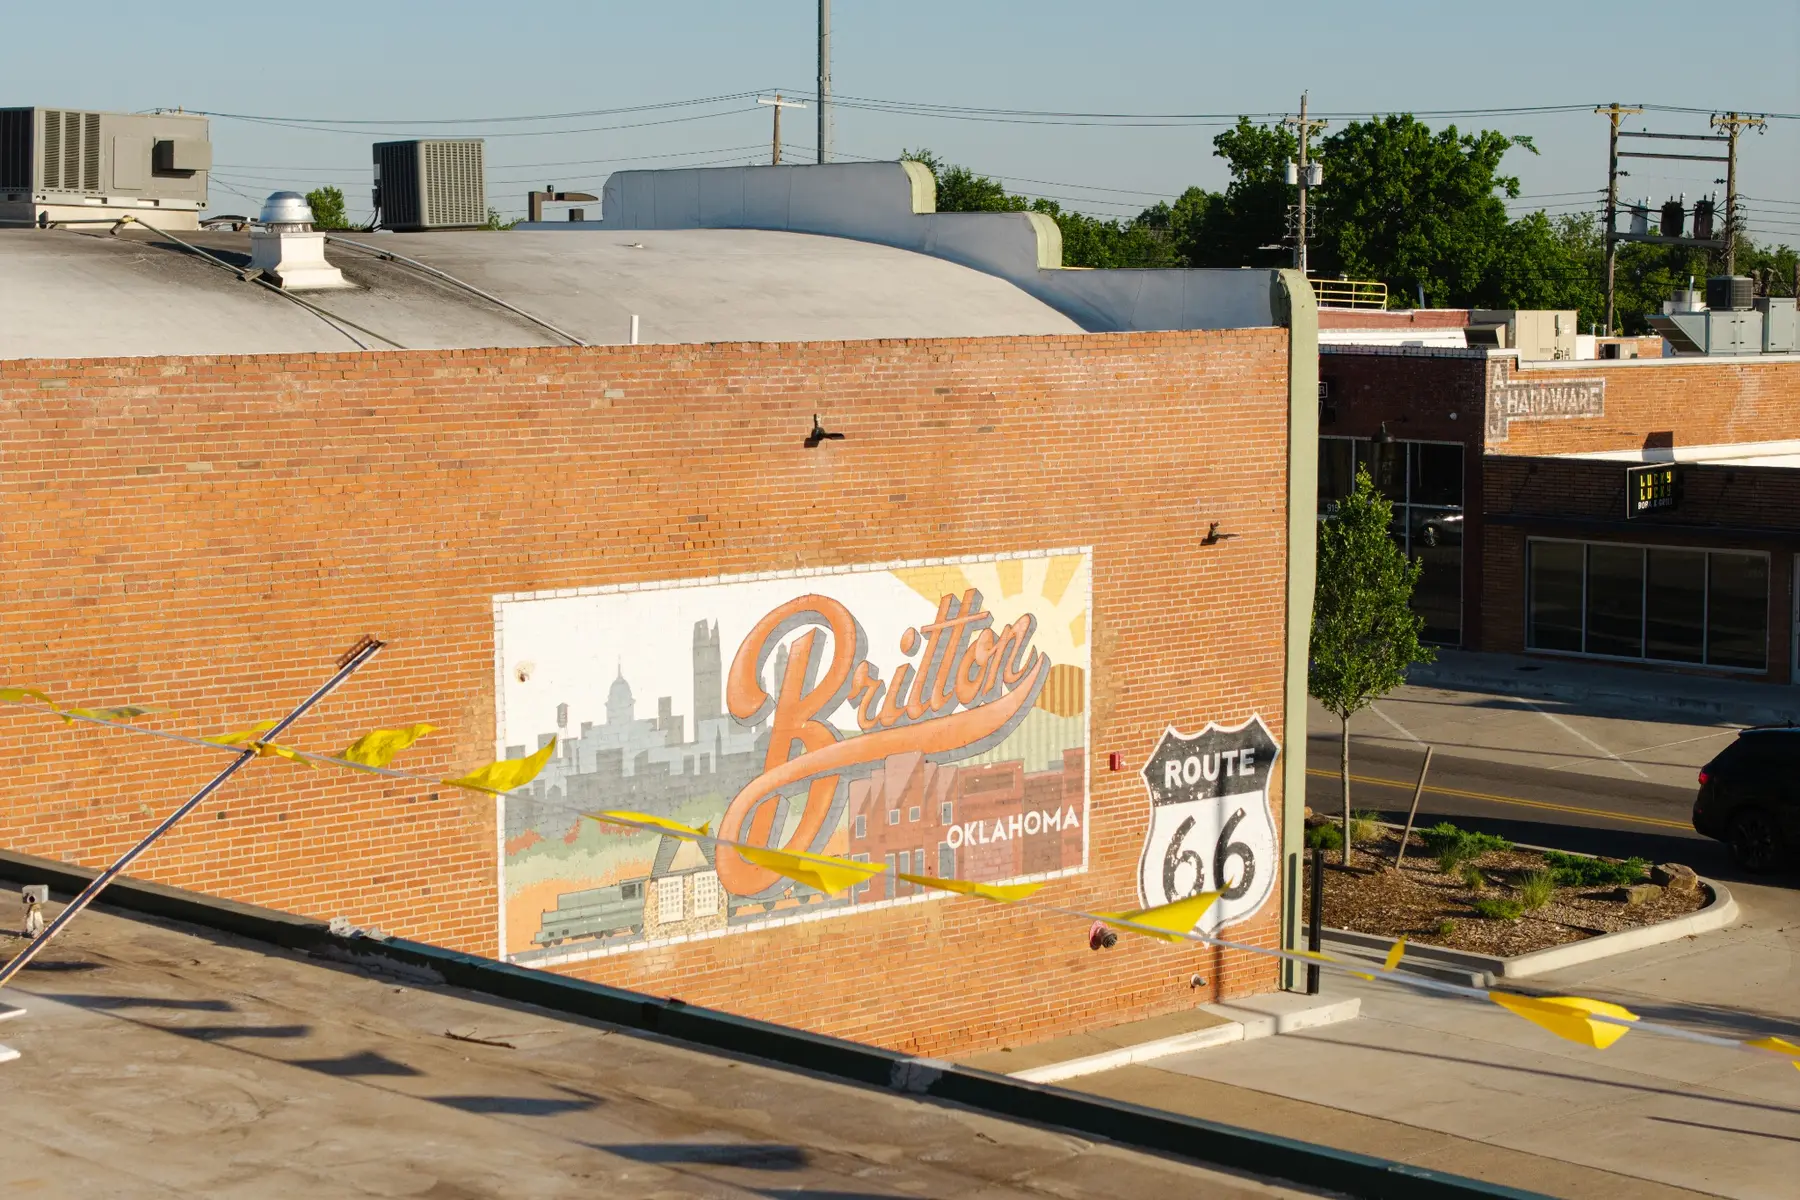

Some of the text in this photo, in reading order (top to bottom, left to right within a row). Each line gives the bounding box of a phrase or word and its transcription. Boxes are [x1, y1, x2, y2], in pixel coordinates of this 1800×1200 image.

[1490, 363, 1505, 435] A & J
[1507, 387, 1600, 414] HARDWARE
[1640, 471, 1671, 487] LUCKY
[1640, 485, 1671, 500] LUCKY
[715, 588, 1051, 900] Britton
[1164, 748, 1256, 789] ROUTE
[947, 804, 1080, 849] OKLAHOMA
[1162, 807, 1256, 904] 66
